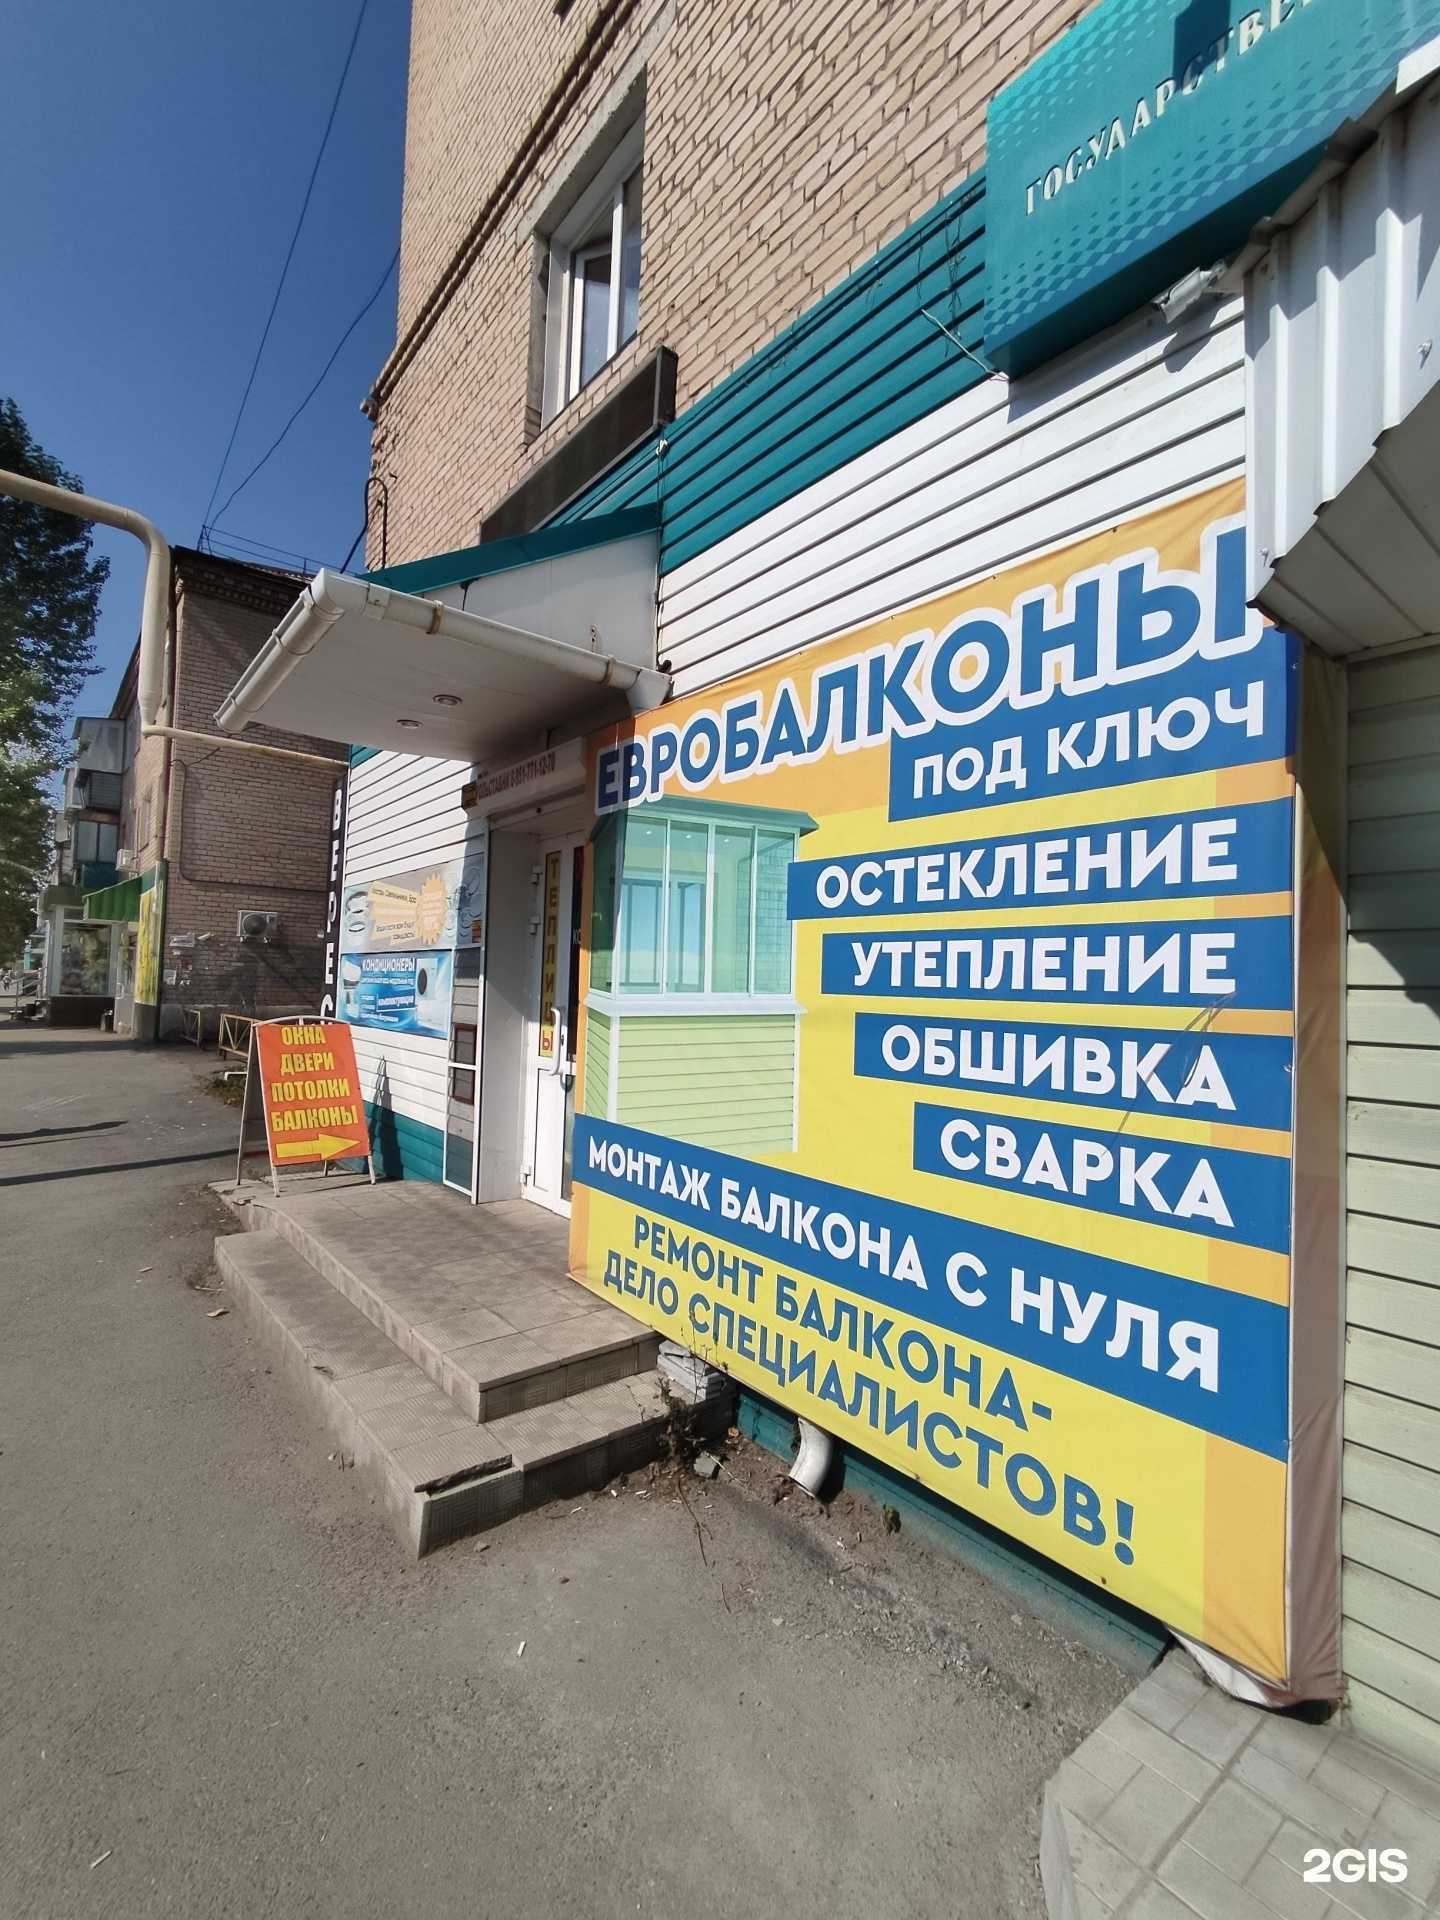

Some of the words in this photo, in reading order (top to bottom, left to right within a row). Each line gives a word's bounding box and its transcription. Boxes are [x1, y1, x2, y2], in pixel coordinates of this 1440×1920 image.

[1026, 0, 1312, 216] ГОСУДАРСТВЕ
[595, 522, 1252, 812] ЕВРОБАЛКОНЫ
[913, 743, 1026, 799] ПОД
[1047, 681, 1264, 775] КЛЮЧ
[816, 818, 1237, 908] ОСТЕКЛЕНИЕ
[362, 957, 415, 974] КОНДИЦИОНЕРЫ
[852, 932, 1236, 993] УТЕПЛЕНИЕ
[280, 1052, 334, 1076] ДВЕРИ
[281, 1026, 326, 1045] ОКНА
[881, 1024, 1237, 1110] ОБШИВКА
[271, 1078, 350, 1102] ПОТОЛКИ
[271, 1105, 359, 1132] БАЛКОНЫ
[940, 1119, 1235, 1227] СВАРКА
[588, 1135, 711, 1211] МОНТАЖ
[720, 1178, 928, 1291] БАЛКОНА
[945, 1252, 988, 1307] С
[1010, 1268, 1220, 1393] НУЛЯ
[633, 1214, 764, 1303] РЕМОНТ
[603, 1249, 679, 1317] ДЕЛО
[688, 1292, 1136, 1566] СПЕЦИАЛИСТОВ!
